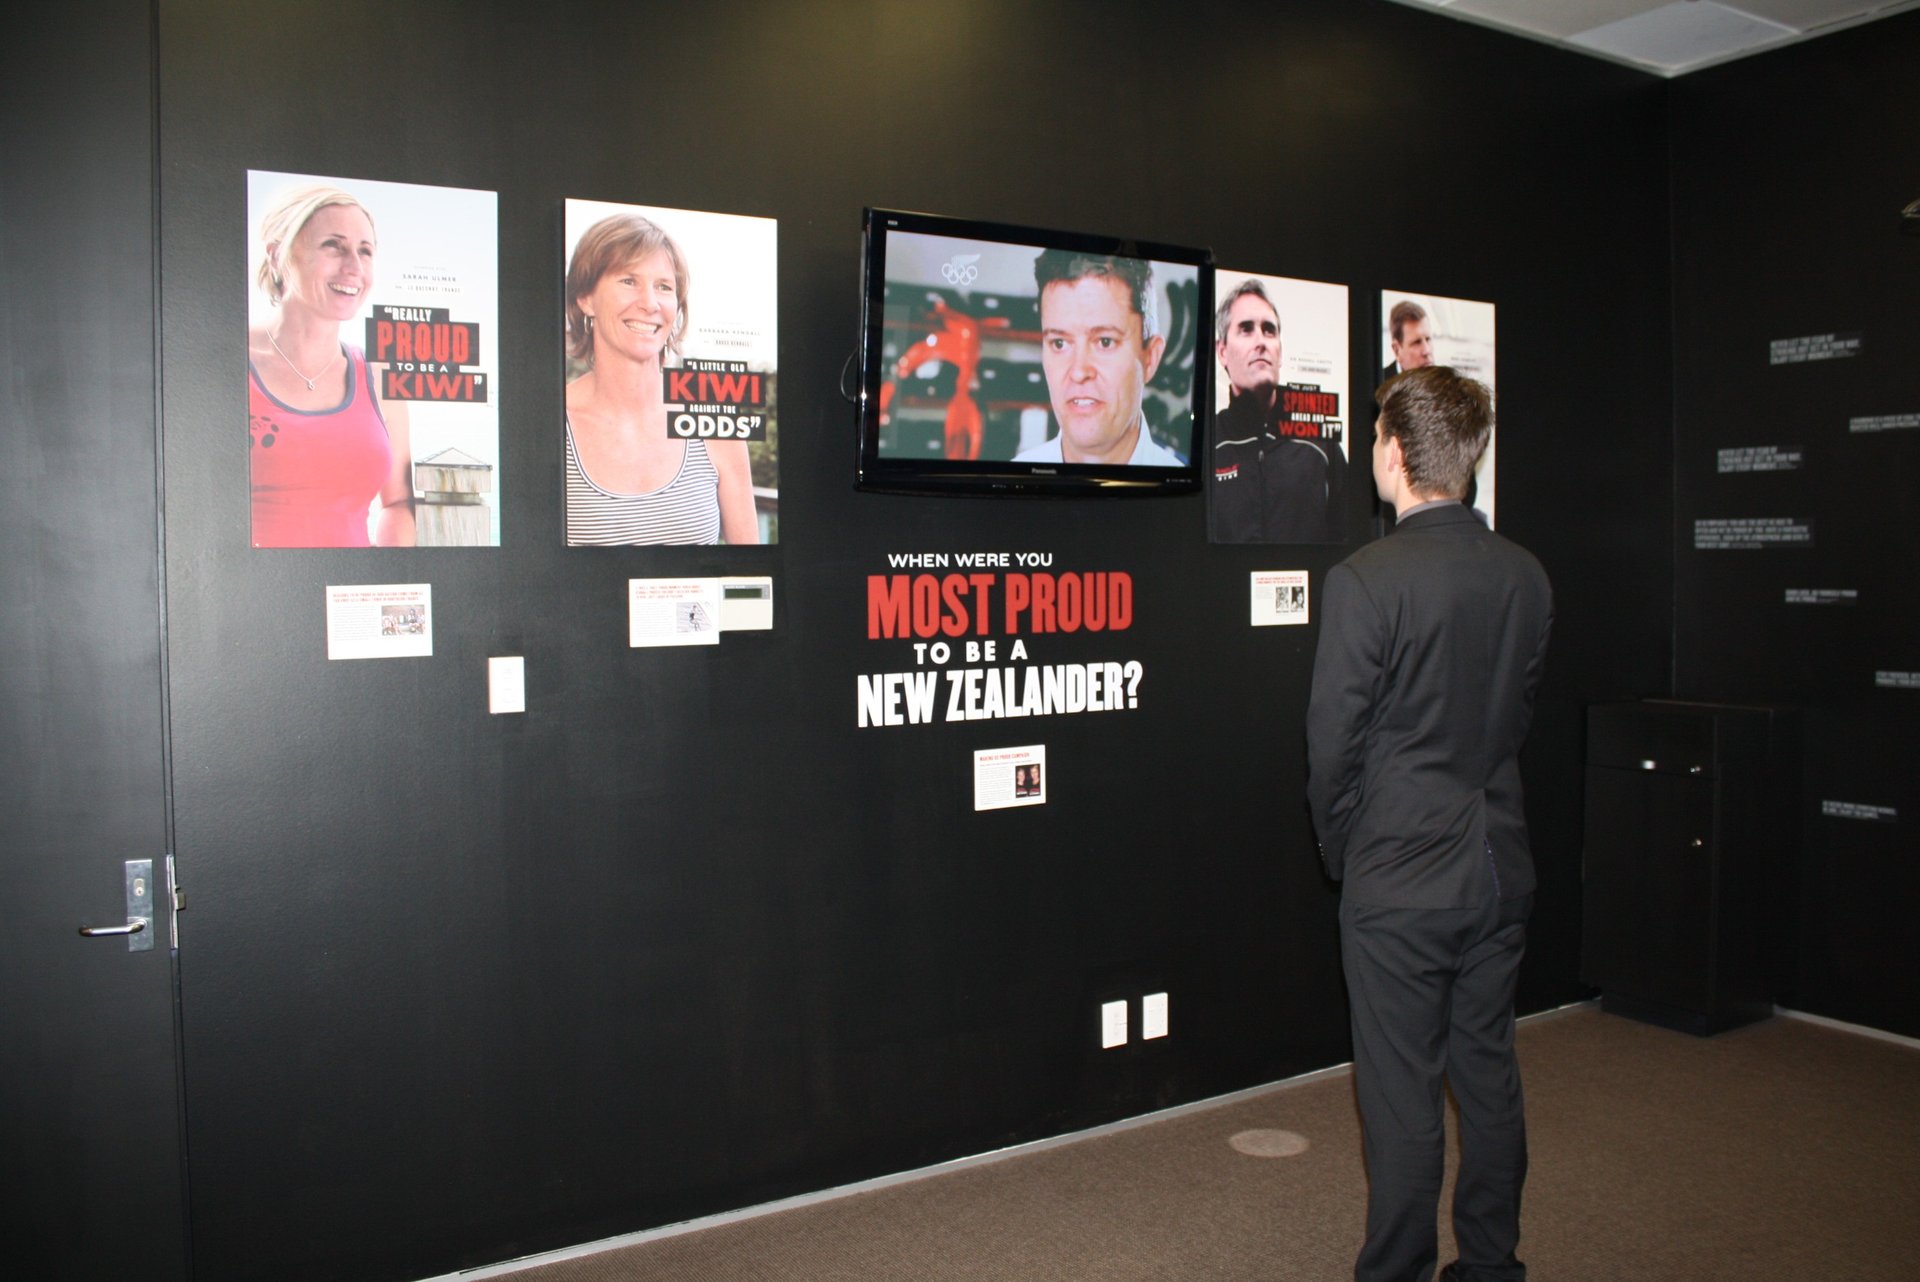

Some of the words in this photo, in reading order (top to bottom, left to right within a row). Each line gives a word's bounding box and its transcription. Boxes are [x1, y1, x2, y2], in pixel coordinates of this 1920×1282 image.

[377, 320, 470, 363] PROUD
[397, 362, 415, 372] TO
[420, 364, 435, 373] BE
[440, 364, 449, 373] A
[700, 361, 726, 372] LITTLE
[730, 363, 745, 373] OLD
[670, 371, 760, 404] KIWI
[689, 404, 720, 414] AGAINST
[723, 405, 736, 414] THE
[1283, 391, 1336, 415] SPRINTED
[1279, 421, 1319, 437] WON
[1031, 467, 1058, 475] Panasonic
[888, 553, 949, 568] WHEN
[955, 553, 1010, 567] WERE
[1015, 553, 1053, 567] YOU
[867, 573, 995, 640] MOST
[1005, 571, 1133, 635] PROUD
[913, 642, 951, 665] TO
[965, 640, 996, 663] BE
[1010, 639, 1028, 660] A
[857, 671, 938, 728] NEW
[945, 660, 1144, 722] ZEALANDER?
